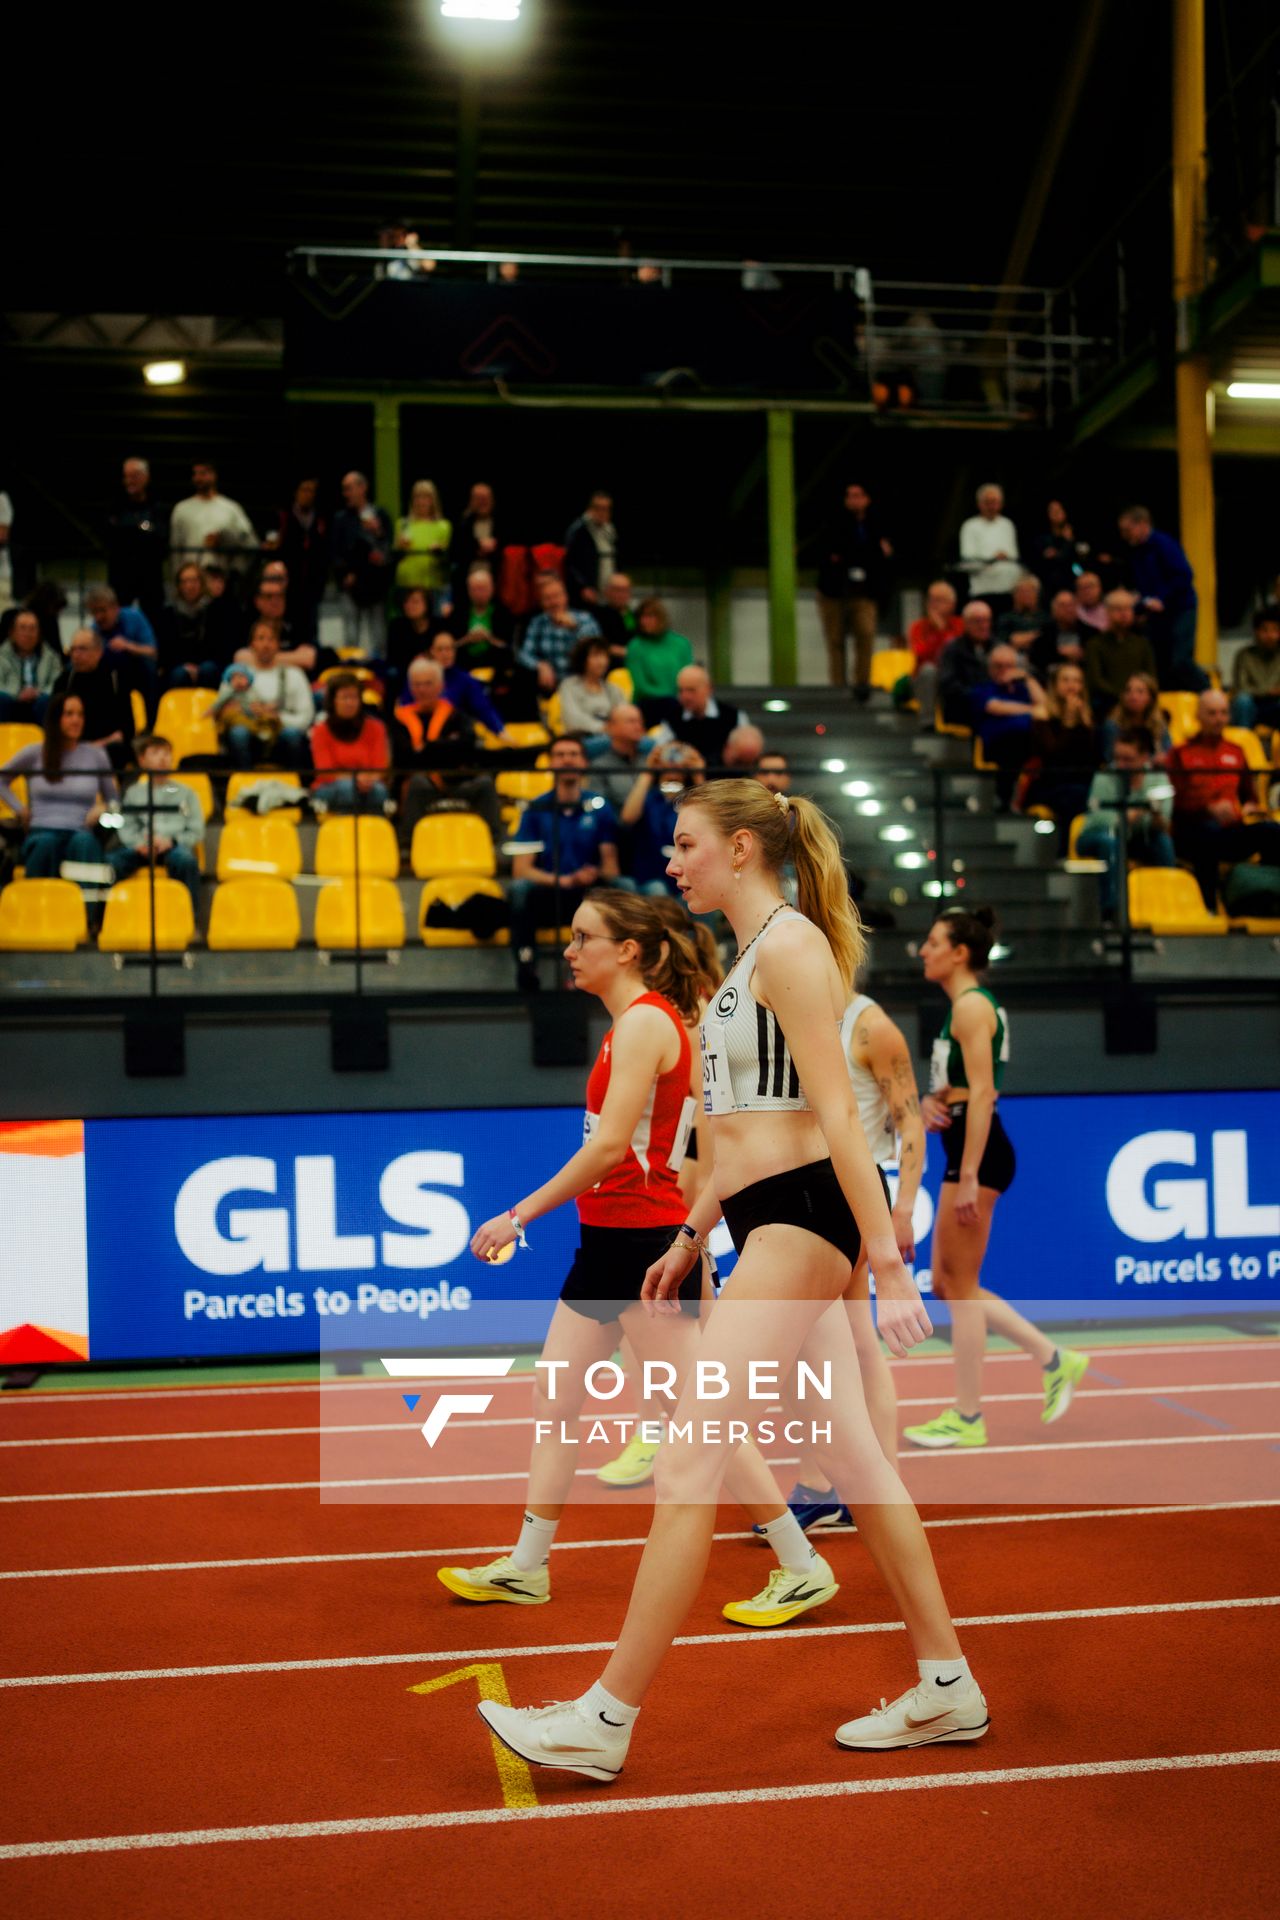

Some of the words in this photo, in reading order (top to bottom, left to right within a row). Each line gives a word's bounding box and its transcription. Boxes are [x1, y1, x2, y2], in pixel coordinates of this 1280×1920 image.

[703, 1054, 717, 1083] ST
[1106, 1129, 1280, 1243] GL
[174, 1150, 470, 1275] GLS
[1115, 1251, 1222, 1285] Parcels
[1228, 1252, 1261, 1280] to
[184, 1286, 305, 1320] Parcels
[313, 1287, 351, 1316] to
[357, 1280, 471, 1320] People
